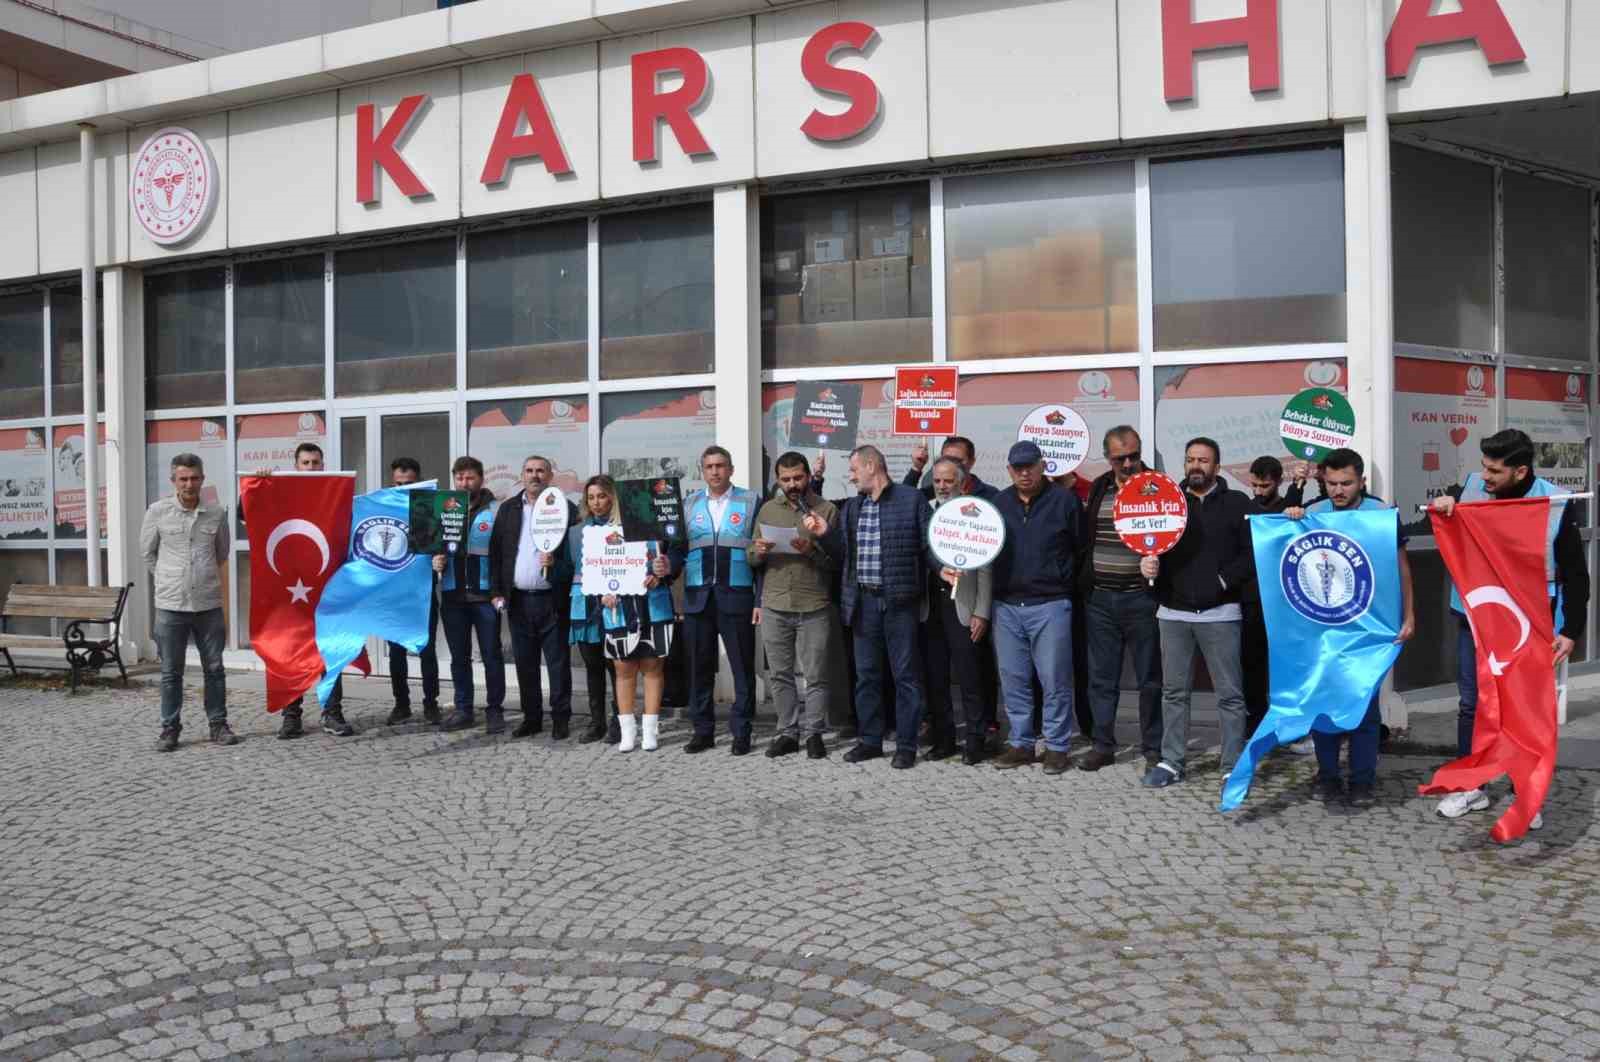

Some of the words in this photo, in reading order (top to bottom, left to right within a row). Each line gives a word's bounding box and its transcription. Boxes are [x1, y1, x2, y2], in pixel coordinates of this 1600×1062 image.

[356, 20, 882, 204] KARS
[910, 409, 941, 419] Yanında
[1411, 411, 1438, 424] KAN
[1441, 412, 1477, 425] VERİN
[1284, 409, 1321, 426] Bebekler
[1322, 416, 1352, 434] Ölüyor,
[1024, 425, 1050, 436] Dünya
[1283, 423, 1310, 438] Dünya
[1311, 430, 1347, 446] Susuyor
[244, 450, 269, 461] KAN
[1131, 518, 1147, 529] Ses
[1148, 518, 1168, 529] Ver!
[1288, 536, 1334, 564] SAĞLIK
[1337, 541, 1363, 568] SEN
